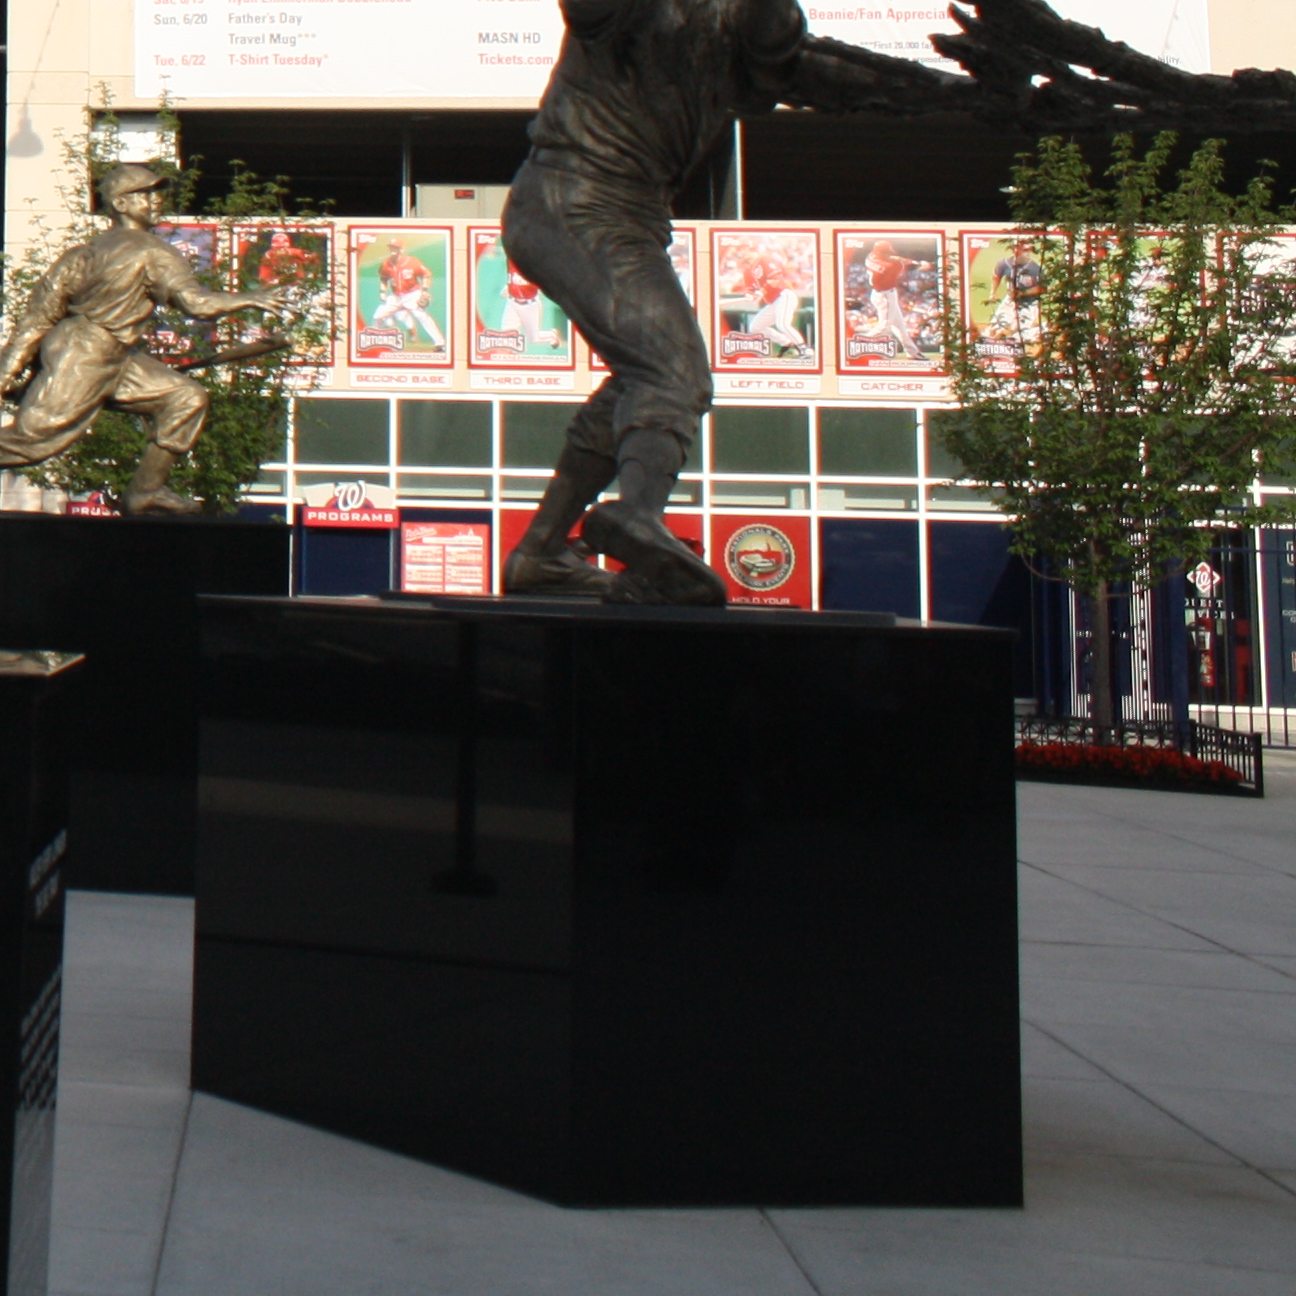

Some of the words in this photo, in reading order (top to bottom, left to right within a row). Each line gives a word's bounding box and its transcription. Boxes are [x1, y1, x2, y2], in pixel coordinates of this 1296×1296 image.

[182, 12, 209, 26] 6/20
[226, 11, 276, 25] Father's
[278, 11, 303, 27] Day
[809, 7, 883, 21] Beanie/Fan
[226, 31, 266, 45] Travel
[477, 31, 520, 45] MASN
[522, 31, 542, 45] HD
[180, 53, 207, 67] 6/22
[226, 52, 269, 67] T-Shirt
[477, 52, 554, 68] Tickets.com
[360, 333, 404, 351] NATIONALS
[478, 334, 525, 352] NATIONALS
[724, 338, 770, 355] NATIONALS
[849, 340, 895, 357] NATIONALS
[356, 374, 408, 384] SECOND
[411, 375, 445, 385] BASE
[483, 376, 522, 386] THIRD
[526, 377, 561, 386] BASE
[730, 379, 765, 389] LEFT
[767, 380, 805, 390] FIELD
[860, 382, 924, 391] CATCHER
[307, 510, 395, 523] PROGRAMS
[732, 596, 761, 605] HOLD
[762, 596, 792, 605] YOUR
